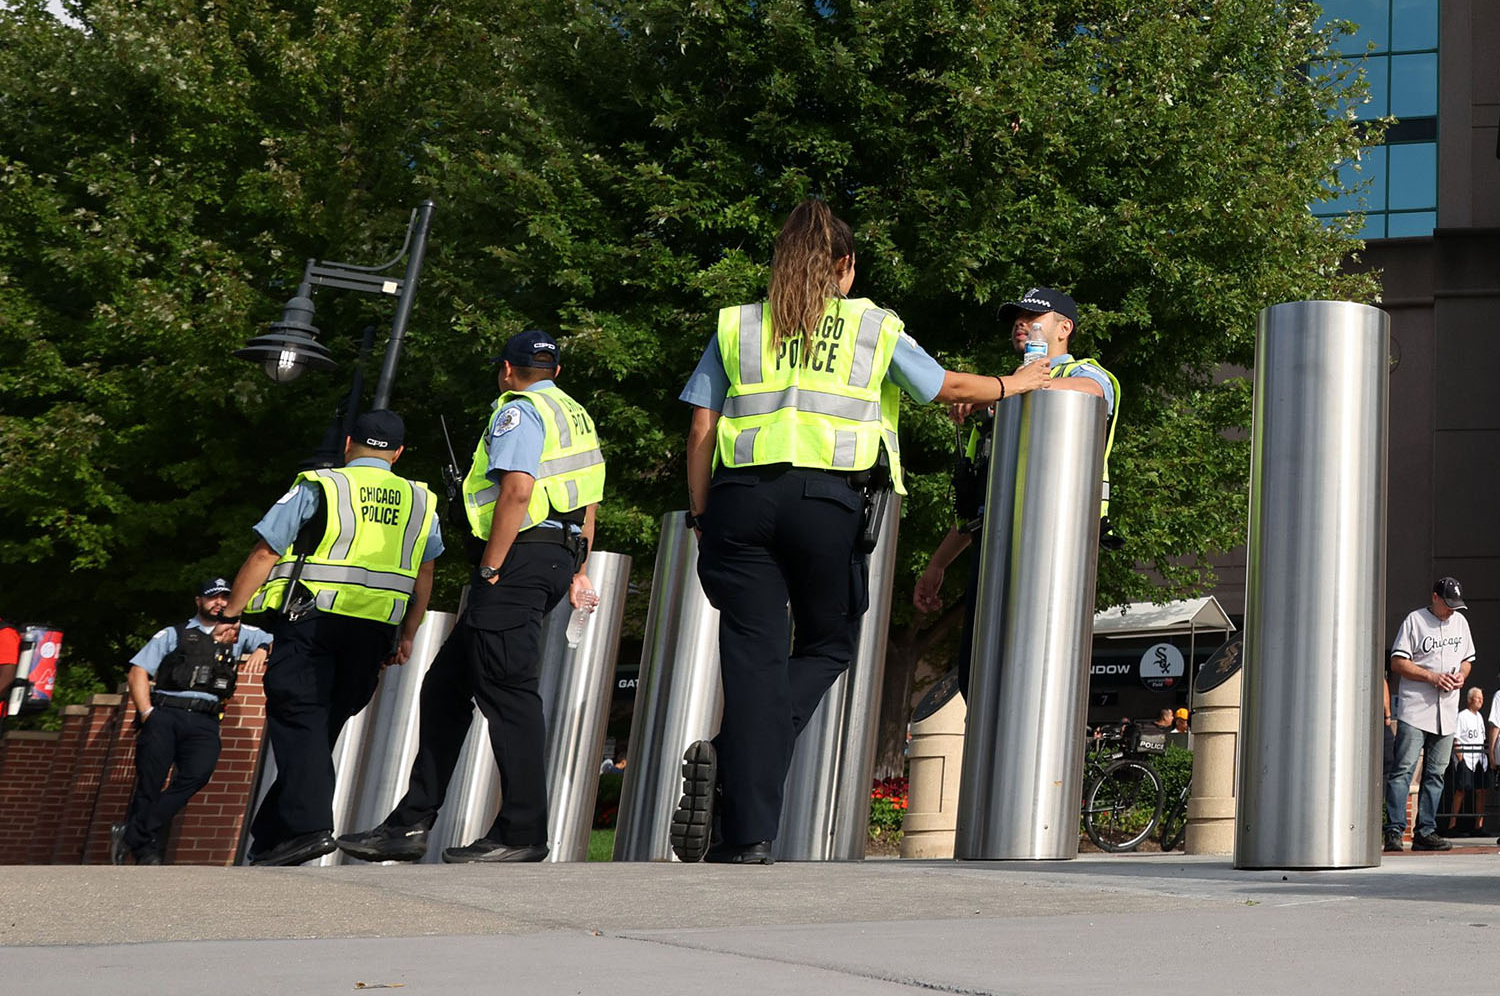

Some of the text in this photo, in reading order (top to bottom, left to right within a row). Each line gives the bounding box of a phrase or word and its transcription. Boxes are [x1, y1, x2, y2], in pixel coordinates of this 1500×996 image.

[366, 438, 388, 448] CPD
[360, 486, 401, 505] CHICAGO
[361, 506, 400, 525] POLICE
[618, 679, 640, 689] GAT
[1139, 740, 1165, 750] POLICE
